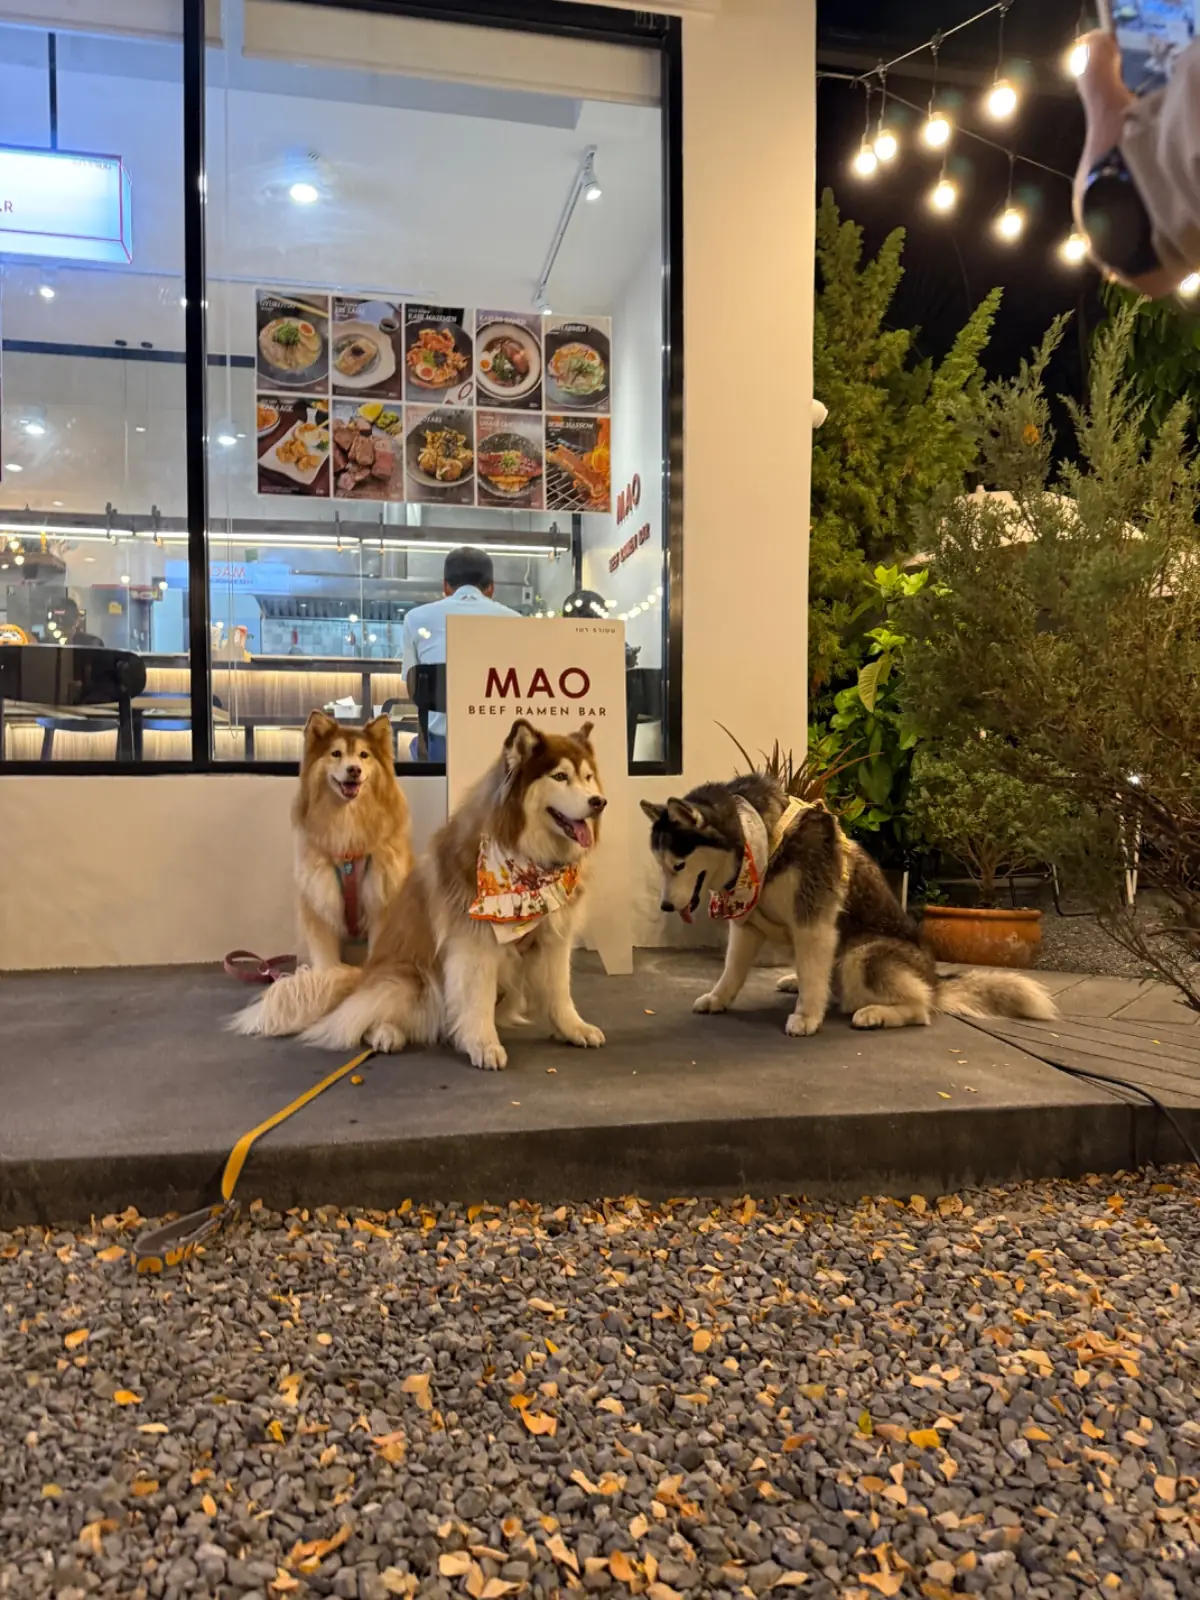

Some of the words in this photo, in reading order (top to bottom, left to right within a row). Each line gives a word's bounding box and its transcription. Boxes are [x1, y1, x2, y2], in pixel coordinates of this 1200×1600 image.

[616, 472, 641, 526] MAO
[485, 667, 590, 699] MAO
[468, 705, 506, 715] BEEF
[515, 705, 569, 716] RAMEN
[578, 707, 607, 717] BAR
